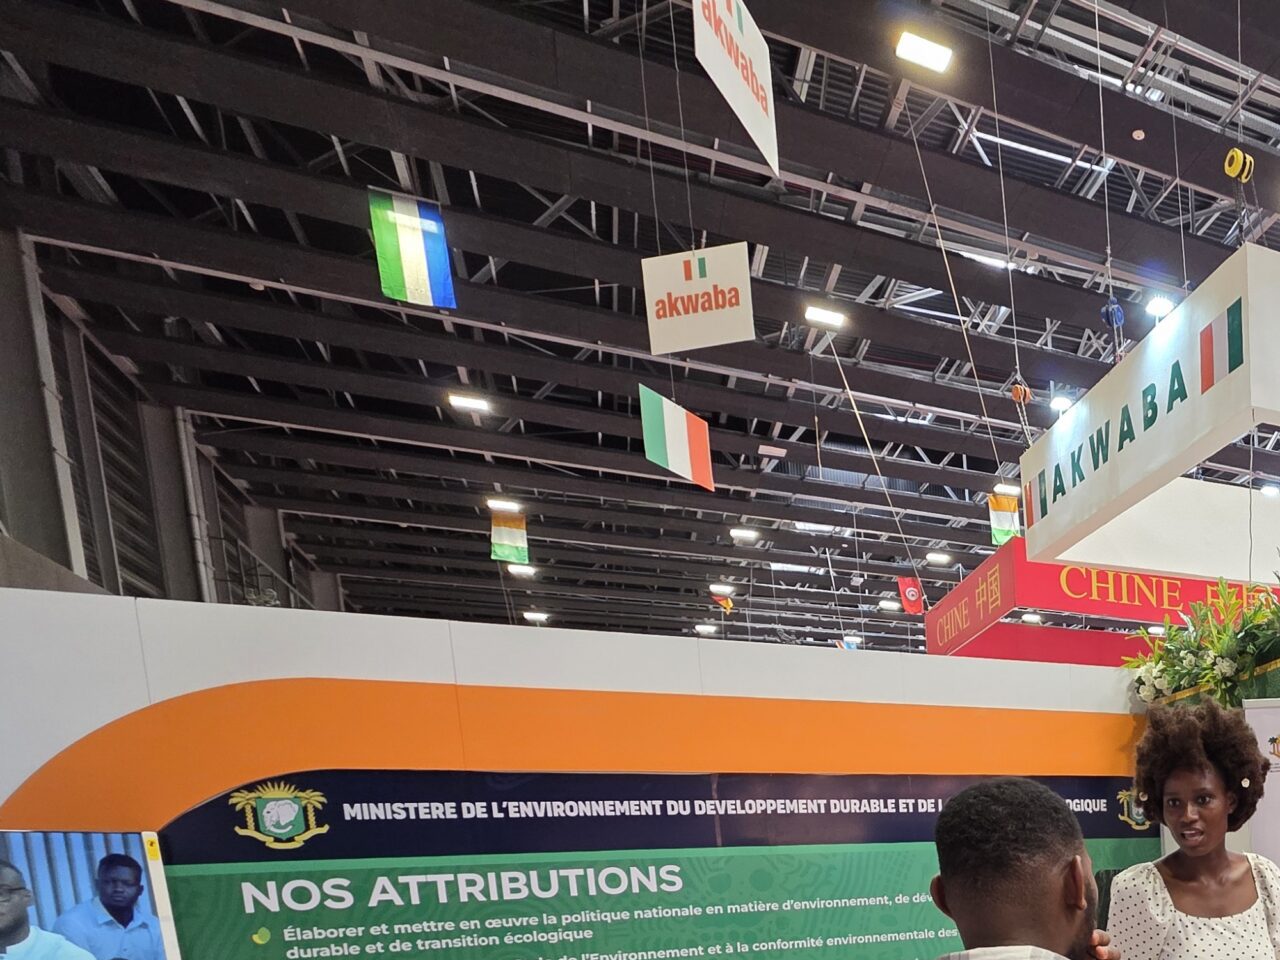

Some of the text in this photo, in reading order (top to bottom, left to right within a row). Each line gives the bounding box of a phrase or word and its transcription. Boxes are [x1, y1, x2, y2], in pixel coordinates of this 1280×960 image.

[701, 0, 769, 118] akwaba
[655, 282, 741, 321] akwaba
[1052, 359, 1188, 505] AKWABA
[936, 563, 1001, 648] CHINE 中国
[1059, 565, 1184, 612] CHINE
[343, 801, 458, 820] MINISTERE
[462, 801, 488, 819] DE
[492, 800, 663, 818] L'ENVIRONNEMENT
[669, 800, 690, 816] DU
[694, 799, 827, 815] DEVELOPPEMENT
[830, 799, 896, 814] DURABLE
[899, 798, 915, 813] ET
[918, 798, 936, 813] DE
[1065, 798, 1108, 814] OGIQUE
[240, 864, 684, 914] NOS ATTRIBUTIONS
[283, 892, 934, 942] Élaborer et mettre en œuvre la politique nationale en matière d'environnement, de dév
[707, 943, 722, 955] et
[725, 942, 734, 953] à
[737, 941, 749, 953] la
[752, 935, 824, 951] conformité
[826, 928, 935, 947] environnementale
[938, 927, 958, 938] des
[286, 927, 594, 960] durable et de transition écologique
